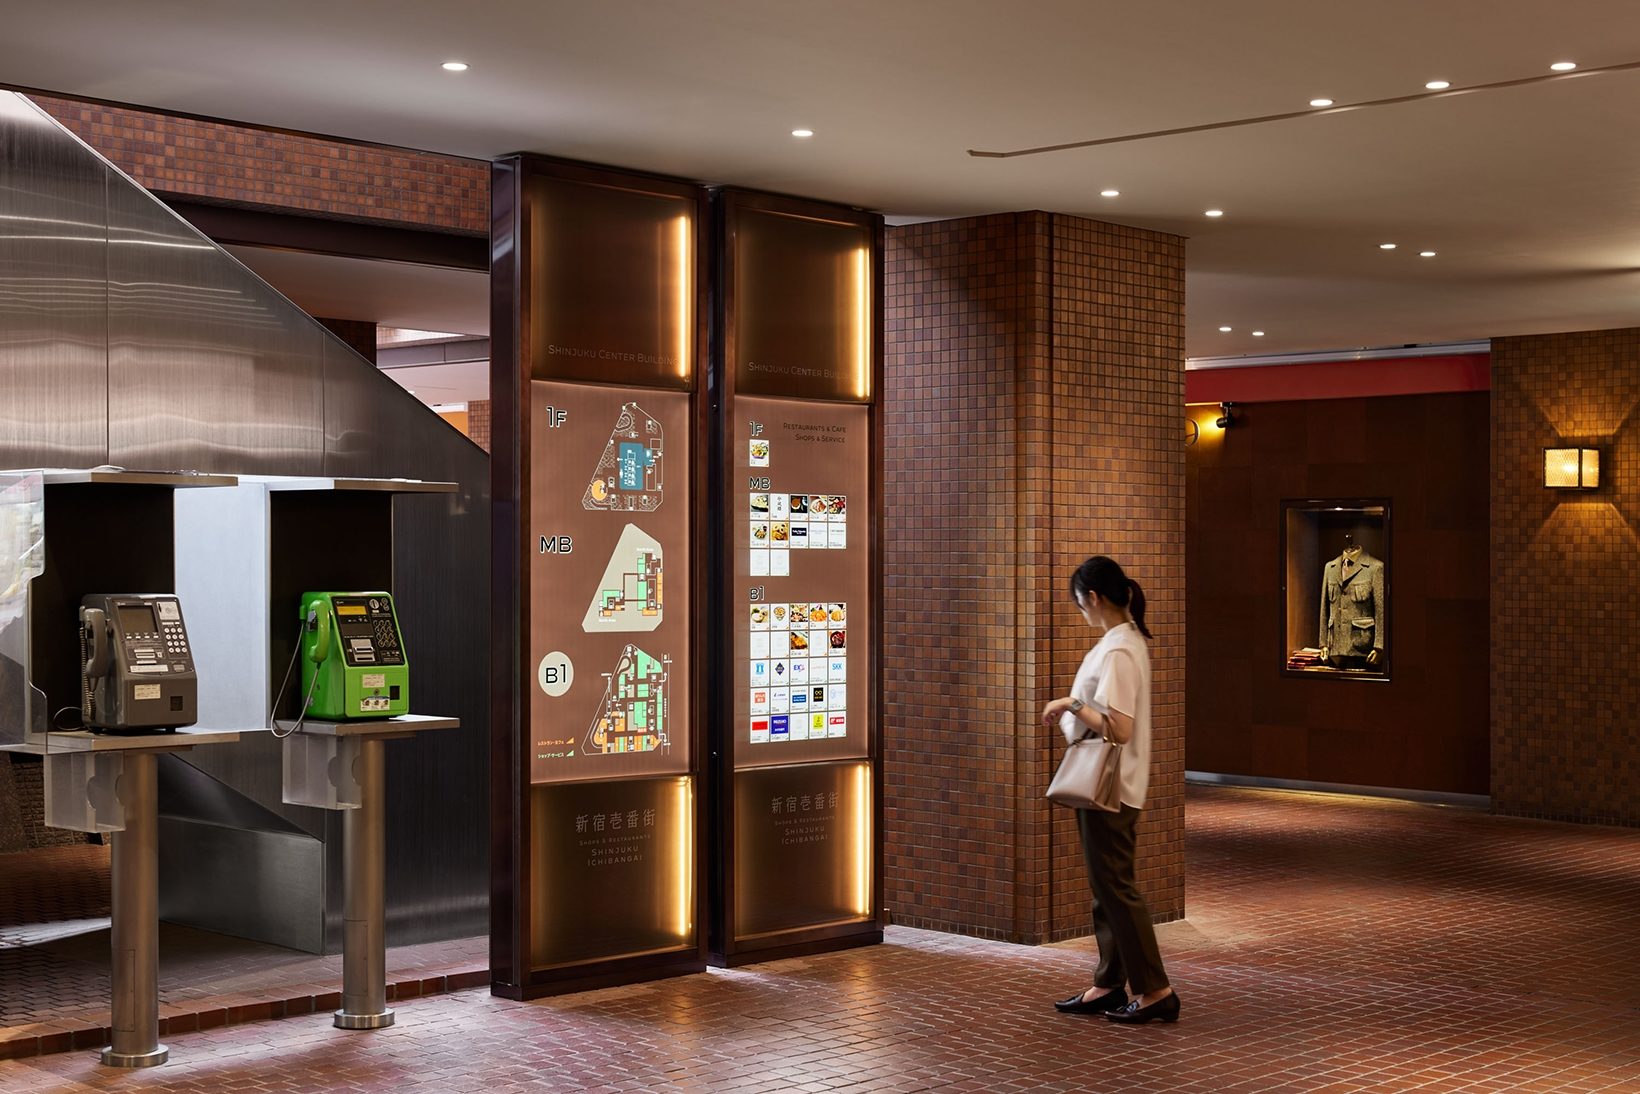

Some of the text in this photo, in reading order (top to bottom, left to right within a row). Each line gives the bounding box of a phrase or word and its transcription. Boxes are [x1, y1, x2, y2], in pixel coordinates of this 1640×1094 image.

[598, 349, 635, 363] CENTER
[546, 406, 567, 428] 1F
[749, 421, 764, 437] 1F
[749, 477, 771, 490] MB
[539, 535, 573, 555] MB
[750, 585, 765, 601] B1
[545, 663, 567, 684] B1
[575, 808, 656, 833] 新宿壱番街
[591, 845, 639, 857] SHINJUKU
[587, 854, 642, 867] ICHIBANGAI
